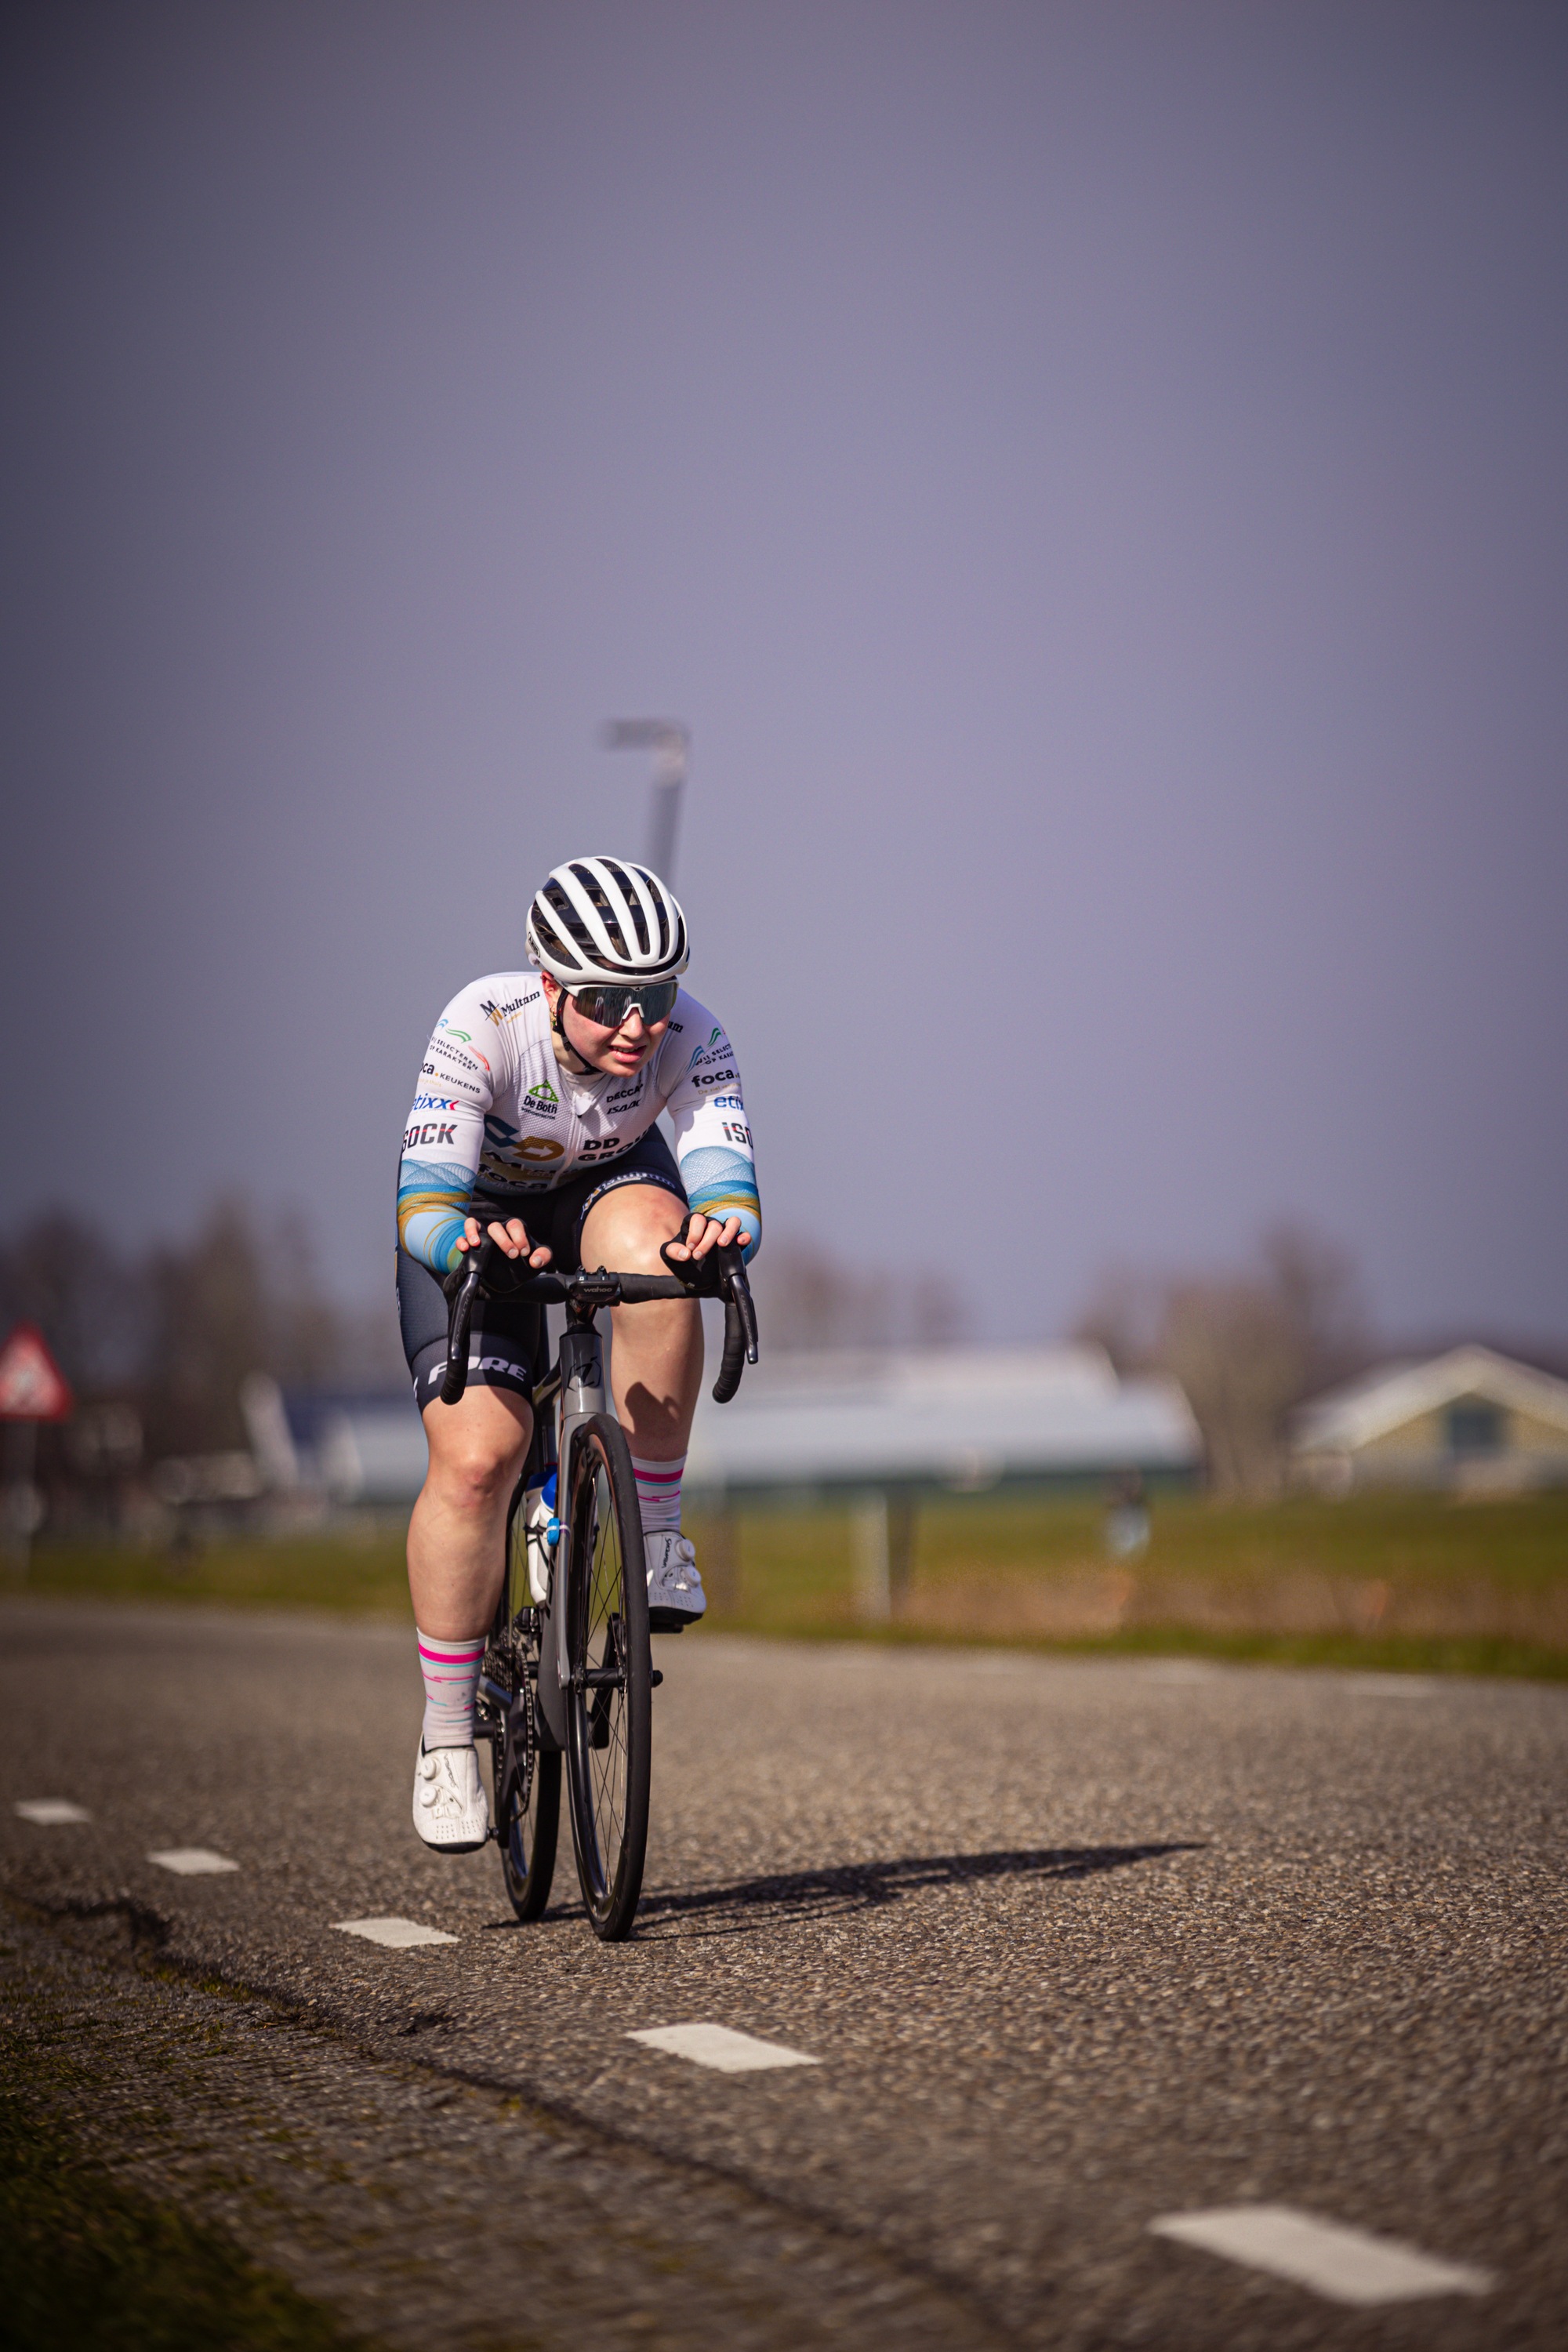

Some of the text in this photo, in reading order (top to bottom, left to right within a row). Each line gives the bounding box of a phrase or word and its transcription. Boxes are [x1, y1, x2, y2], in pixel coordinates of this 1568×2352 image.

[436, 1047, 472, 1070] KARAKTER
[437, 1039, 478, 1070] SELECTEREN
[440, 1073, 481, 1094] KEUKENS
[524, 1095, 535, 1108] De
[536, 1101, 557, 1114] Both
[583, 1138, 619, 1150] DD
